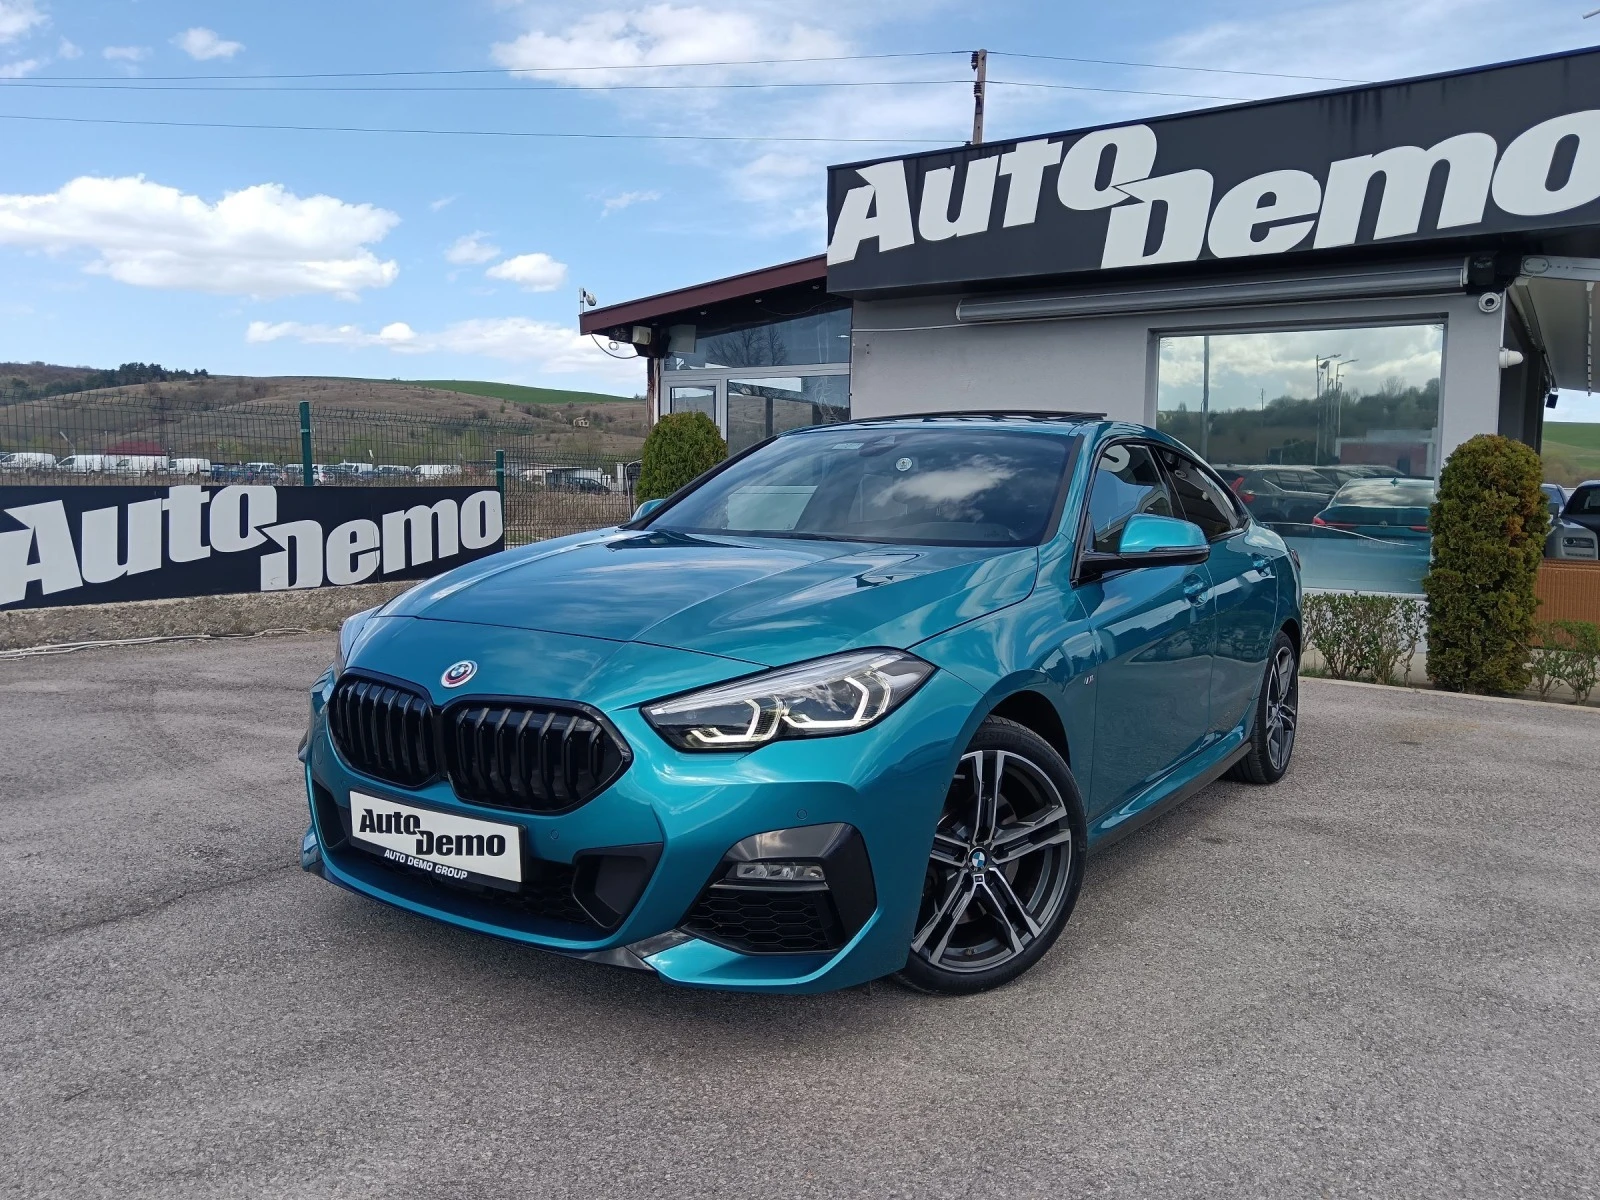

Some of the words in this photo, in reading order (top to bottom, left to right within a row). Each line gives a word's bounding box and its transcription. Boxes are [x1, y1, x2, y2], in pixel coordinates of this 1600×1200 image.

[828, 124, 1158, 264] Auto
[1101, 110, 1600, 269] Demo
[0, 484, 279, 605] Auto
[260, 490, 503, 591] Demo
[359, 808, 421, 835] Auto
[415, 831, 506, 857] Demo
[384, 849, 406, 863] AUTO
[407, 857, 433, 872] DEMO
[434, 865, 468, 880] GROUP
